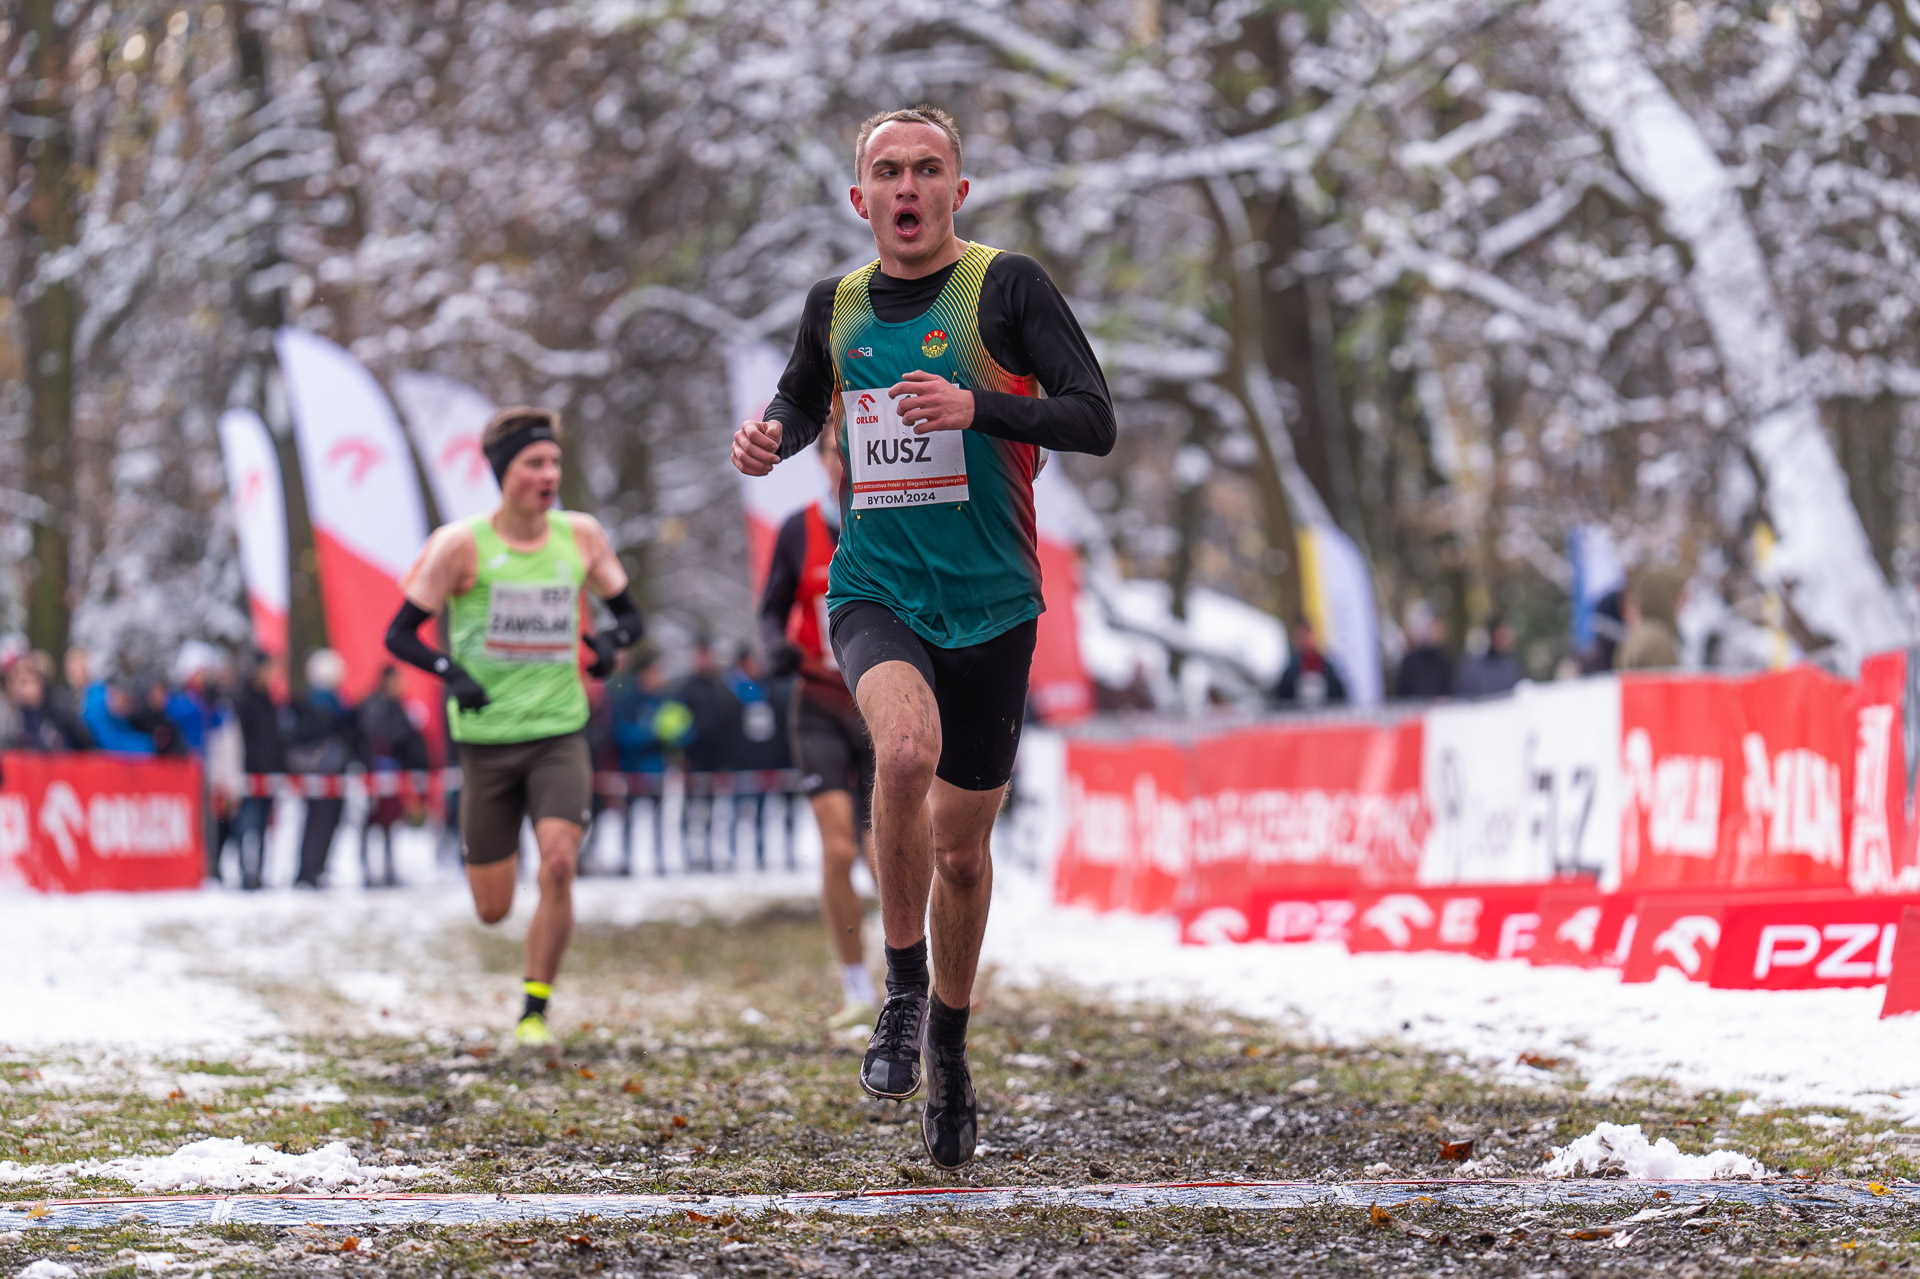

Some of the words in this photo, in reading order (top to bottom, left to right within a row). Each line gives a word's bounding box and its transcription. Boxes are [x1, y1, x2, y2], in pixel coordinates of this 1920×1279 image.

[856, 415, 879, 425] ORLEN
[867, 437, 932, 466] KUSZ
[887, 480, 901, 488] Polski
[867, 494, 904, 505] BYTOM
[906, 491, 936, 503] 2024
